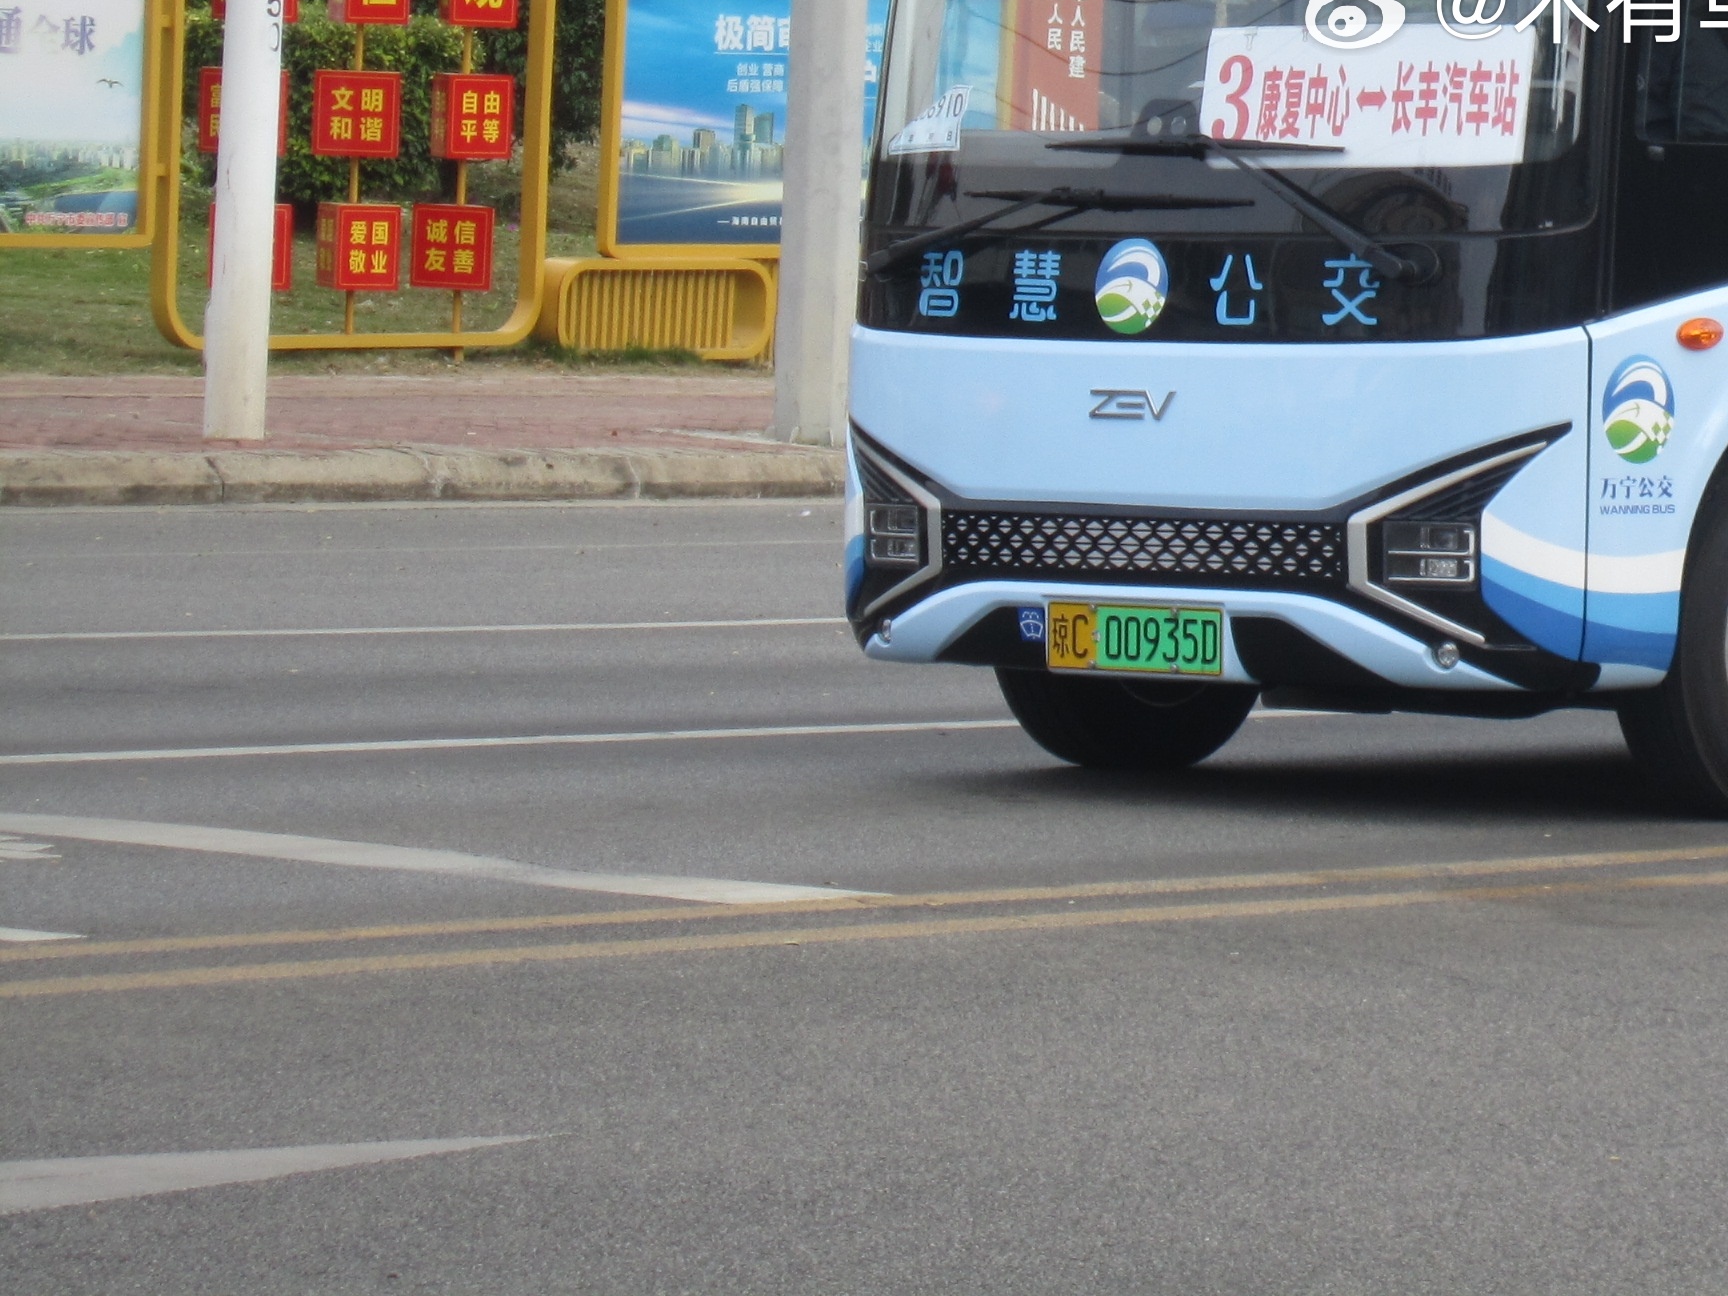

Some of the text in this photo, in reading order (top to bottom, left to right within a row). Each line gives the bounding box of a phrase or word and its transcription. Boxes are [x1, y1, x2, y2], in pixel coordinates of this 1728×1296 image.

[331, 87, 384, 112] 文明
[462, 90, 500, 115] 自由
[1211, 54, 1520, 141] 3 康复中心 长丰汽车站
[330, 116, 383, 142] 和谐
[460, 119, 500, 143] 平等
[350, 220, 389, 245] 爱国
[426, 219, 476, 245] 诚信
[349, 249, 388, 274] 敬业
[424, 247, 475, 274] 友善
[1089, 388, 1177, 421] ZEV
[1601, 475, 1674, 499] 万宁公交
[1600, 504, 1675, 515] WANNING BUS
